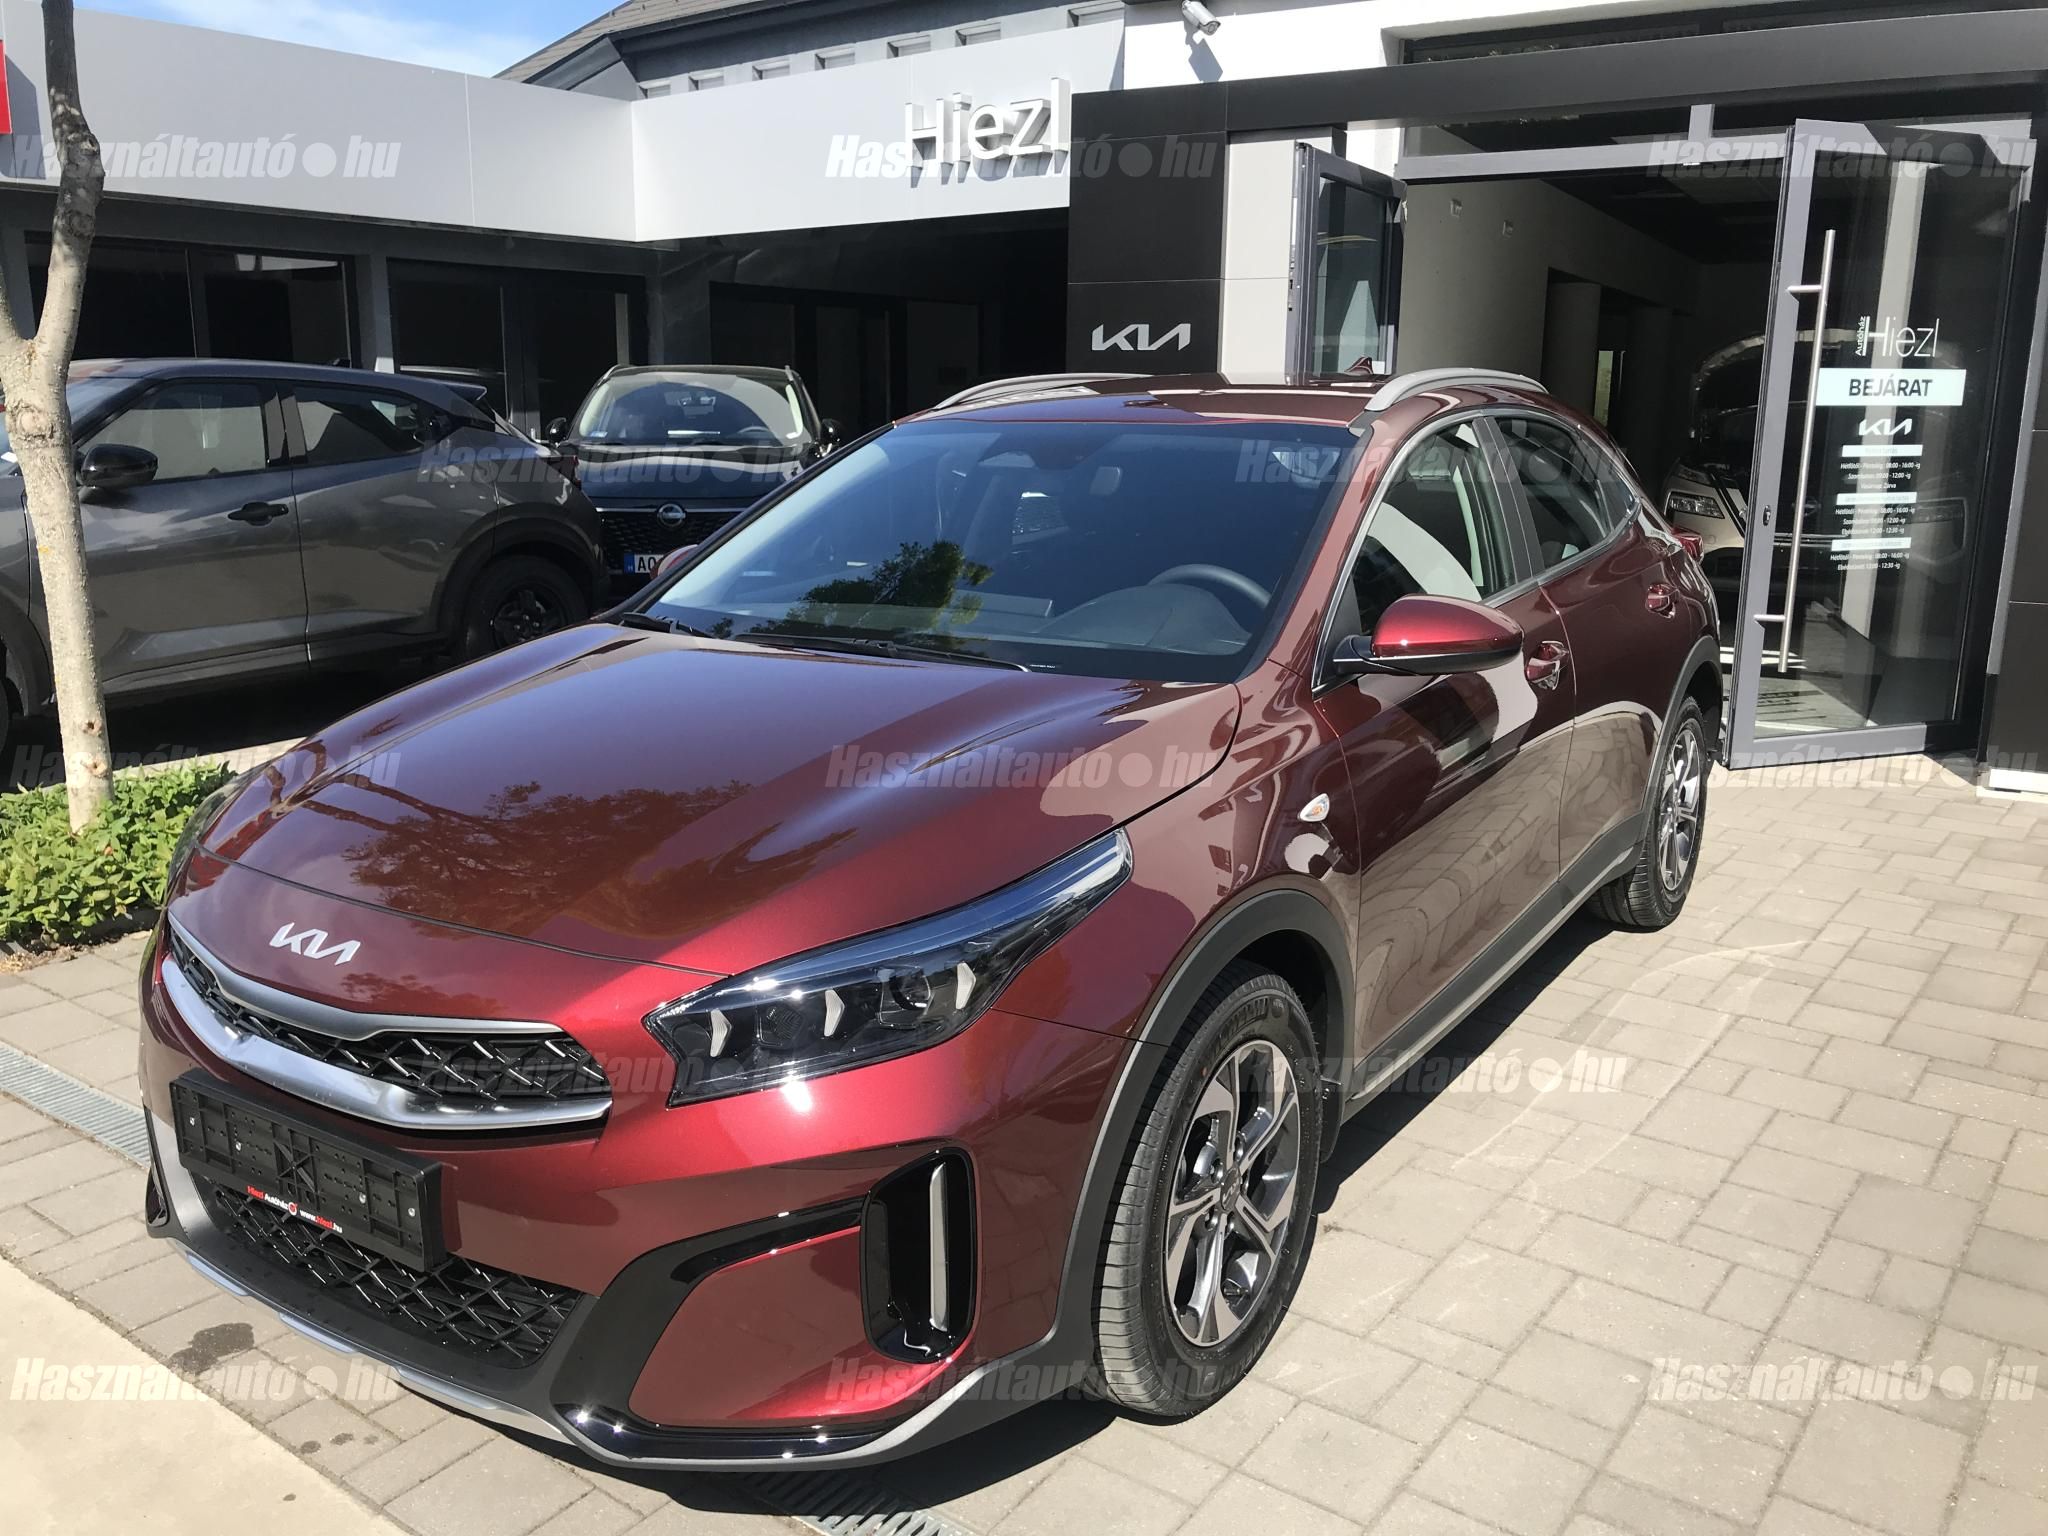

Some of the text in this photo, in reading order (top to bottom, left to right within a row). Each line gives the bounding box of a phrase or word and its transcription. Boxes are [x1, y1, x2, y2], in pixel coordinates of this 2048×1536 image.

[905, 77, 1071, 167] Hiezl
[1092, 323, 1191, 350] KIA
[1855, 316, 1939, 357] Autóház Hiezl
[1849, 374, 1933, 397] BEJÁRAT
[1859, 418, 1912, 436] KIA
[269, 922, 361, 966] KIA
